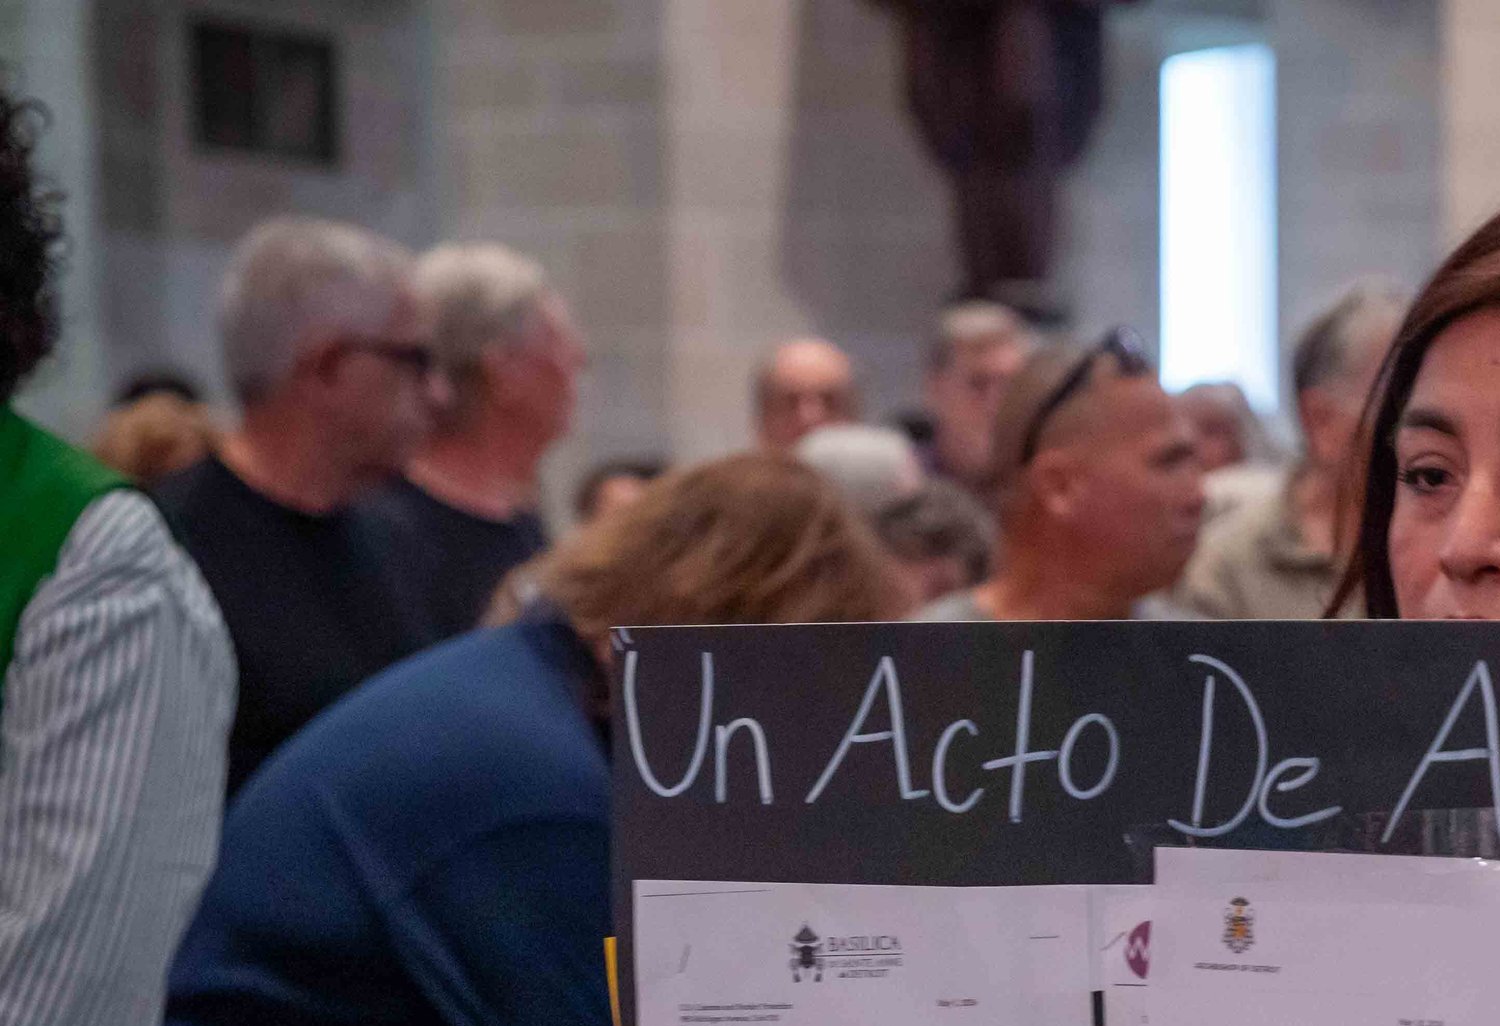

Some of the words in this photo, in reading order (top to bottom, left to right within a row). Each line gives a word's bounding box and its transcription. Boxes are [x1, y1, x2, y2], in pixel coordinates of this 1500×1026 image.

[805, 649, 1120, 823] Acto
[1168, 653, 1342, 838] De
[826, 935, 902, 953] BASILICA
